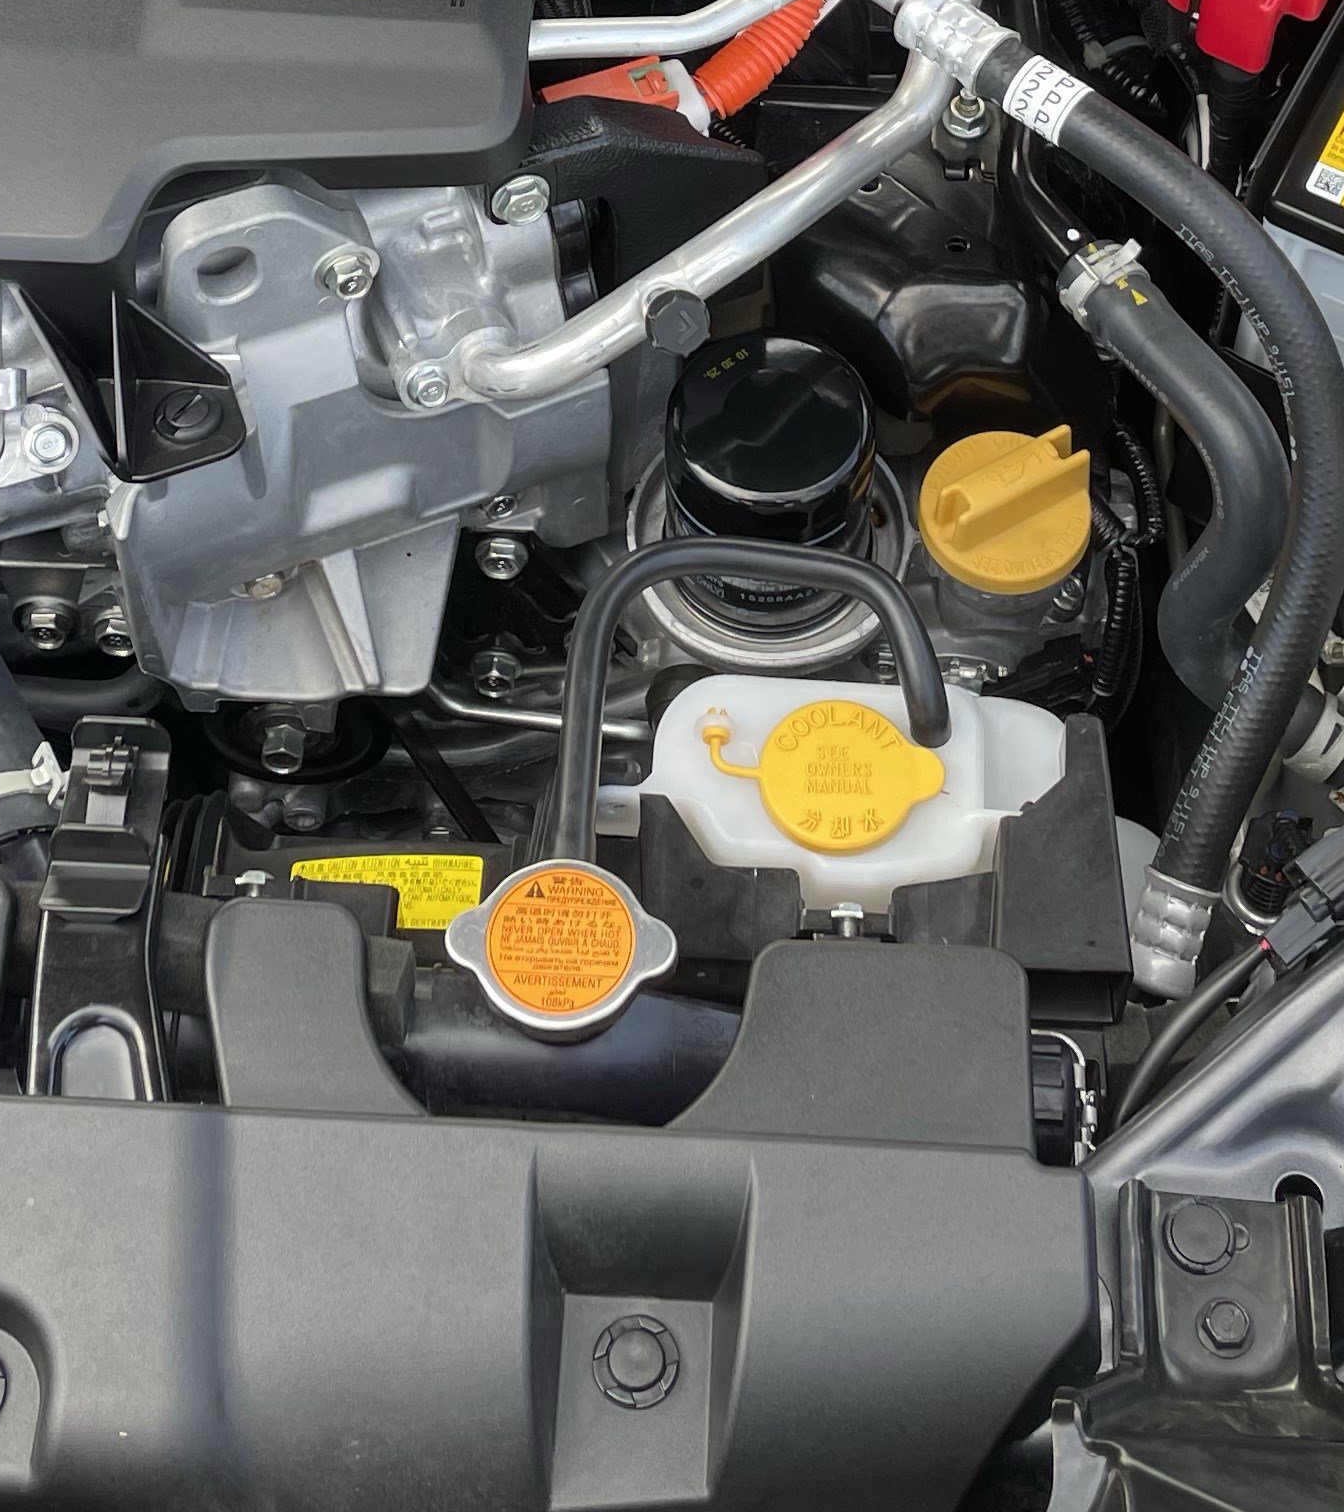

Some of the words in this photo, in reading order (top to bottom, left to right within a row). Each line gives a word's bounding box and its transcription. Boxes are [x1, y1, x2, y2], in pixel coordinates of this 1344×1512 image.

[775, 705, 901, 750] COOLANT
[817, 745, 849, 760] SEE
[805, 779, 872, 793] MANUAL
[548, 885, 603, 896] WARNING
[502, 925, 532, 934] NEVER
[541, 926, 563, 936] OPEN
[567, 927, 596, 938] WHEN
[513, 974, 602, 989] AVERTISSEMENT
